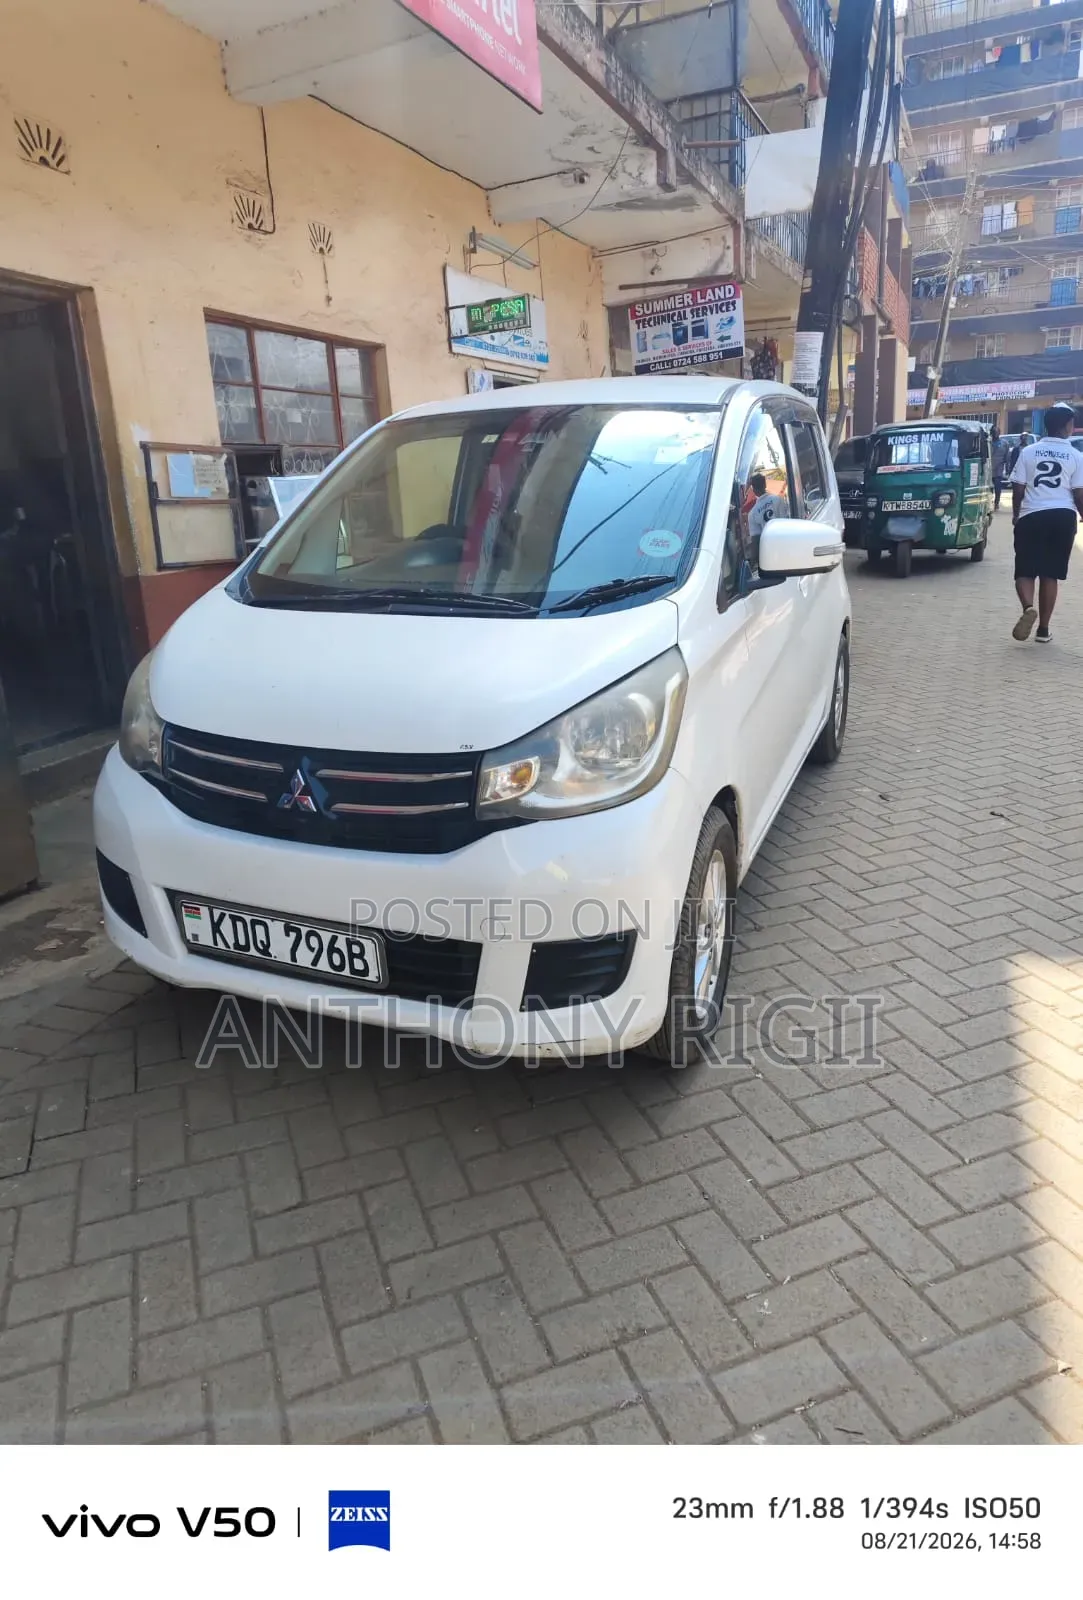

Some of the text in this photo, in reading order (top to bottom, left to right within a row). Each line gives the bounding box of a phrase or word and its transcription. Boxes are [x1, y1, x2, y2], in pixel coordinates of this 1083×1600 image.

[635, 284, 735, 316] SUMMER LAND
[635, 300, 737, 330] TECHNICAL SERVICES
[649, 361, 672, 372] CALL:
[673, 357, 692, 367] 0724
[708, 351, 723, 361] 951
[887, 432, 944, 446] KINGS MAN
[1034, 460, 1063, 489] 2
[207, 906, 370, 978] KDQ 796B
